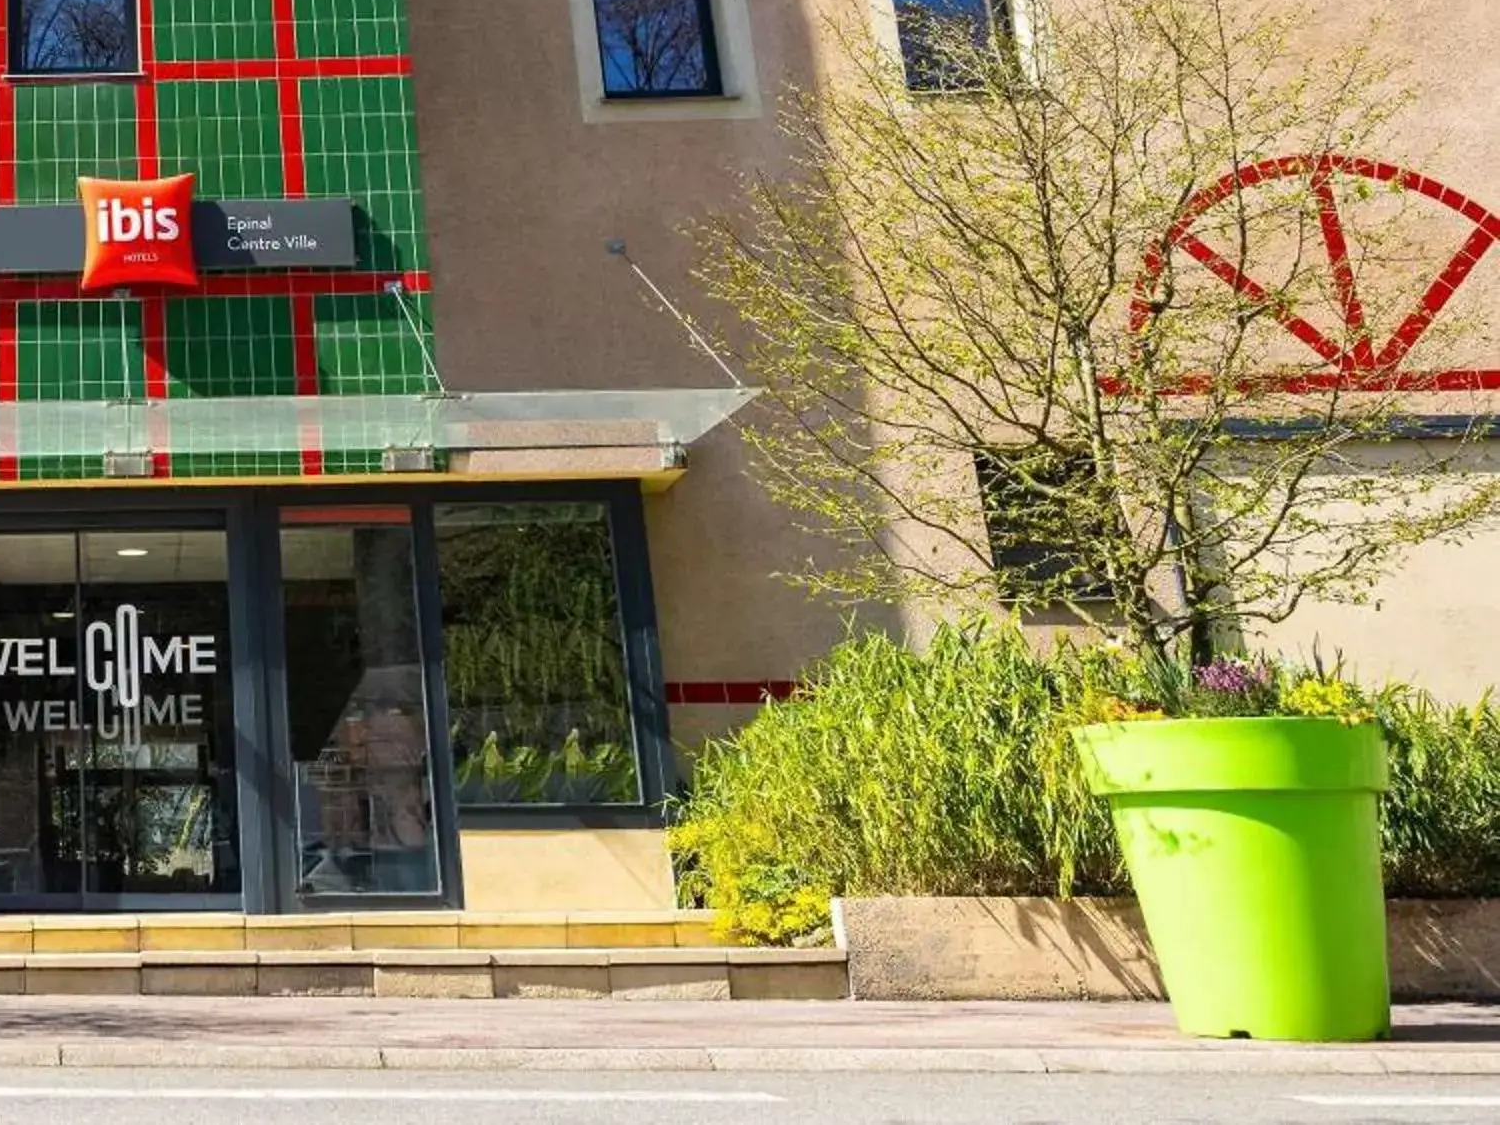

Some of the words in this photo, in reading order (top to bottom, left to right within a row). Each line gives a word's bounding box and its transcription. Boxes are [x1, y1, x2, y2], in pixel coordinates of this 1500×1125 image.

[97, 196, 179, 243] ibis
[227, 214, 272, 234] Epinal
[227, 236, 281, 250] Centre
[283, 235, 317, 249] Ville
[123, 253, 160, 264] HOTELS
